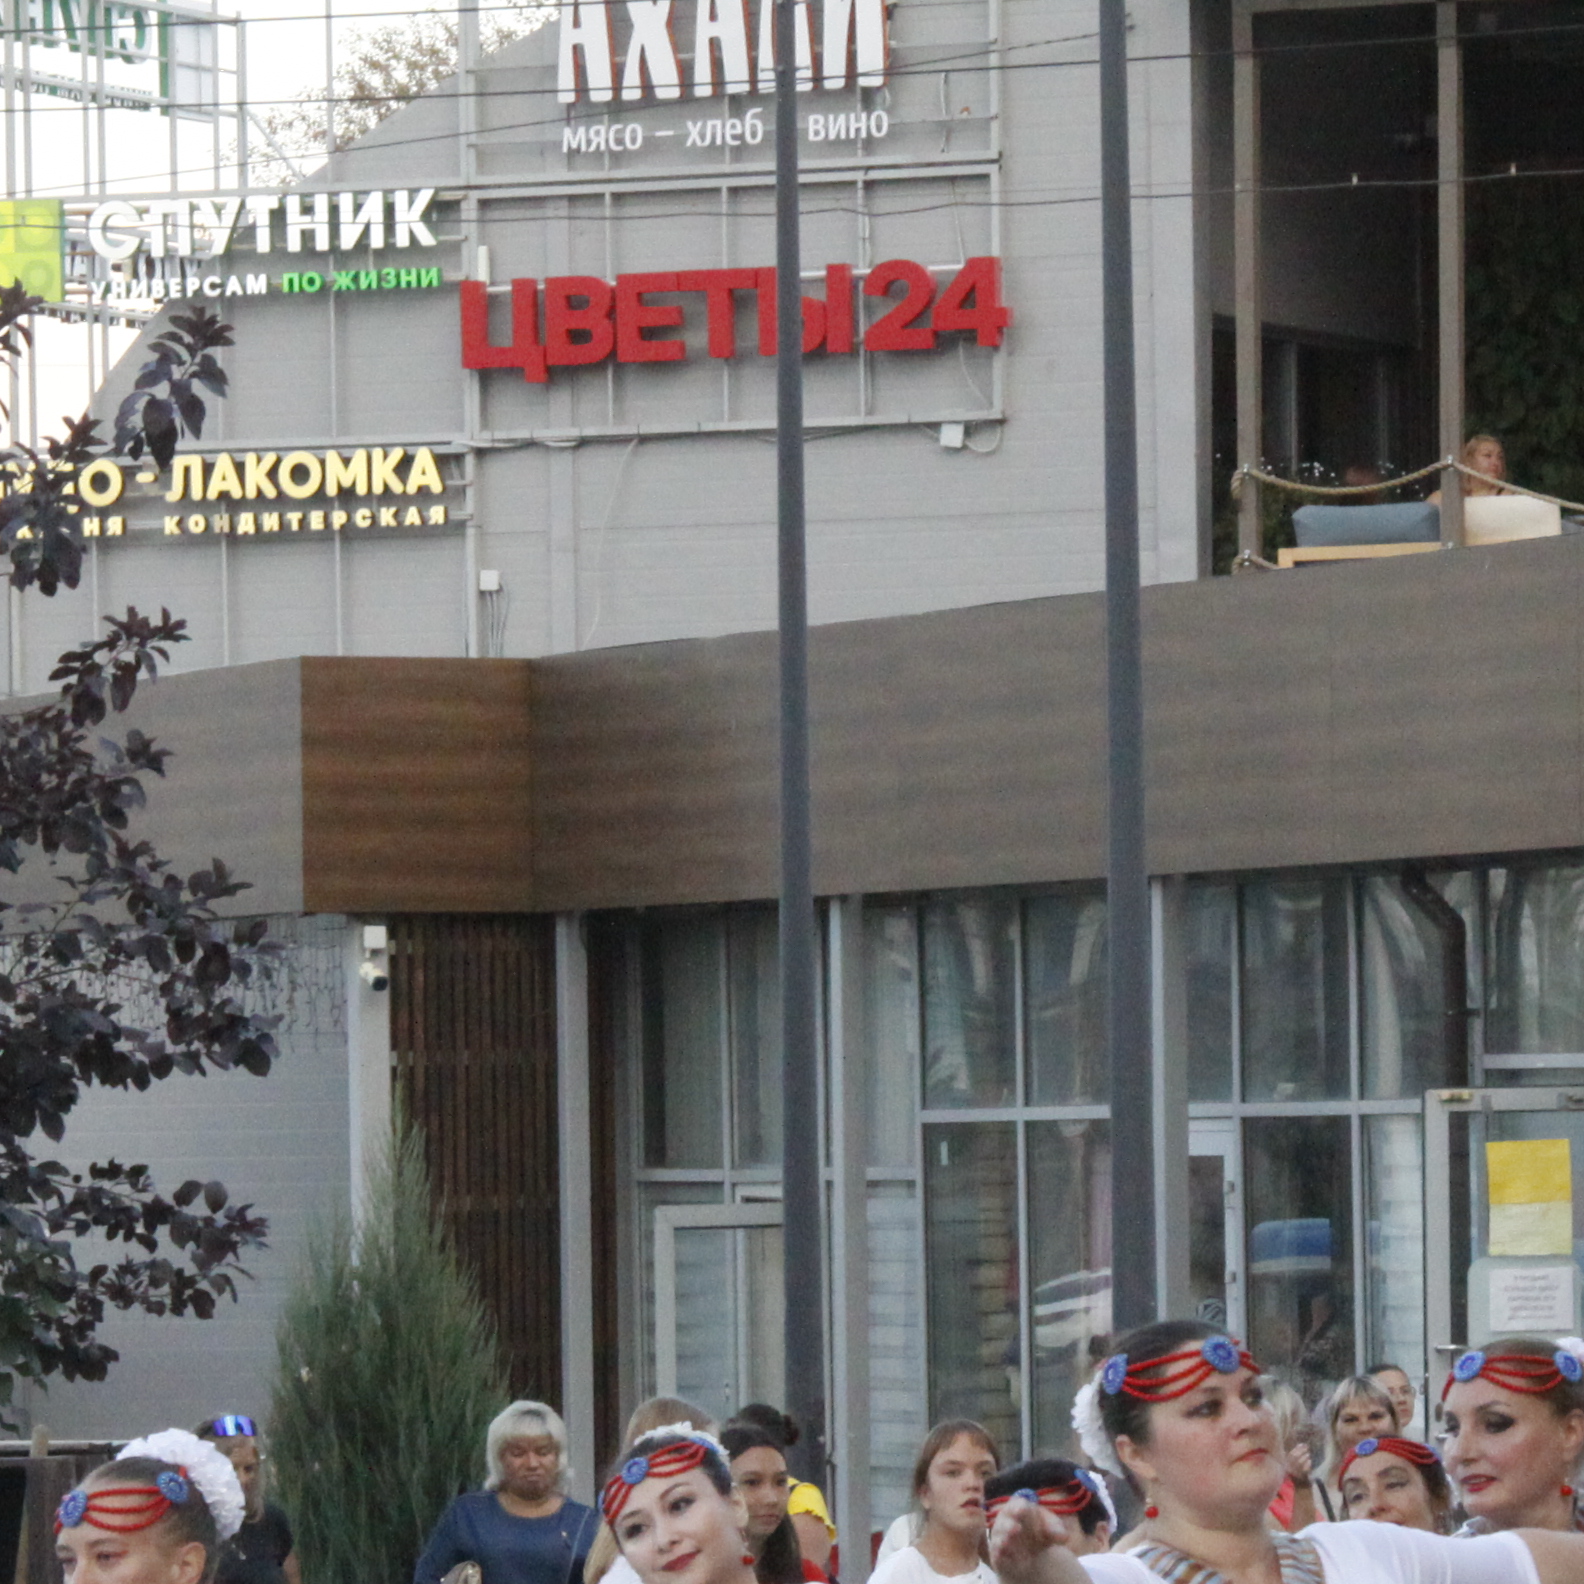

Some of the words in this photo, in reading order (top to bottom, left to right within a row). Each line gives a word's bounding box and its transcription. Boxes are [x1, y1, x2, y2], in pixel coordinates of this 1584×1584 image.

[562, 123, 643, 153] мясо
[686, 108, 764, 148] хлеб
[808, 110, 889, 142] вино
[89, 187, 438, 260] СПУТНИК
[91, 274, 268, 300] УНИВЕРСАМ
[282, 271, 324, 294] ПО
[332, 266, 441, 292] ЖИЗНИ
[163, 504, 447, 536] КОНДИТЕРСКАЯ
